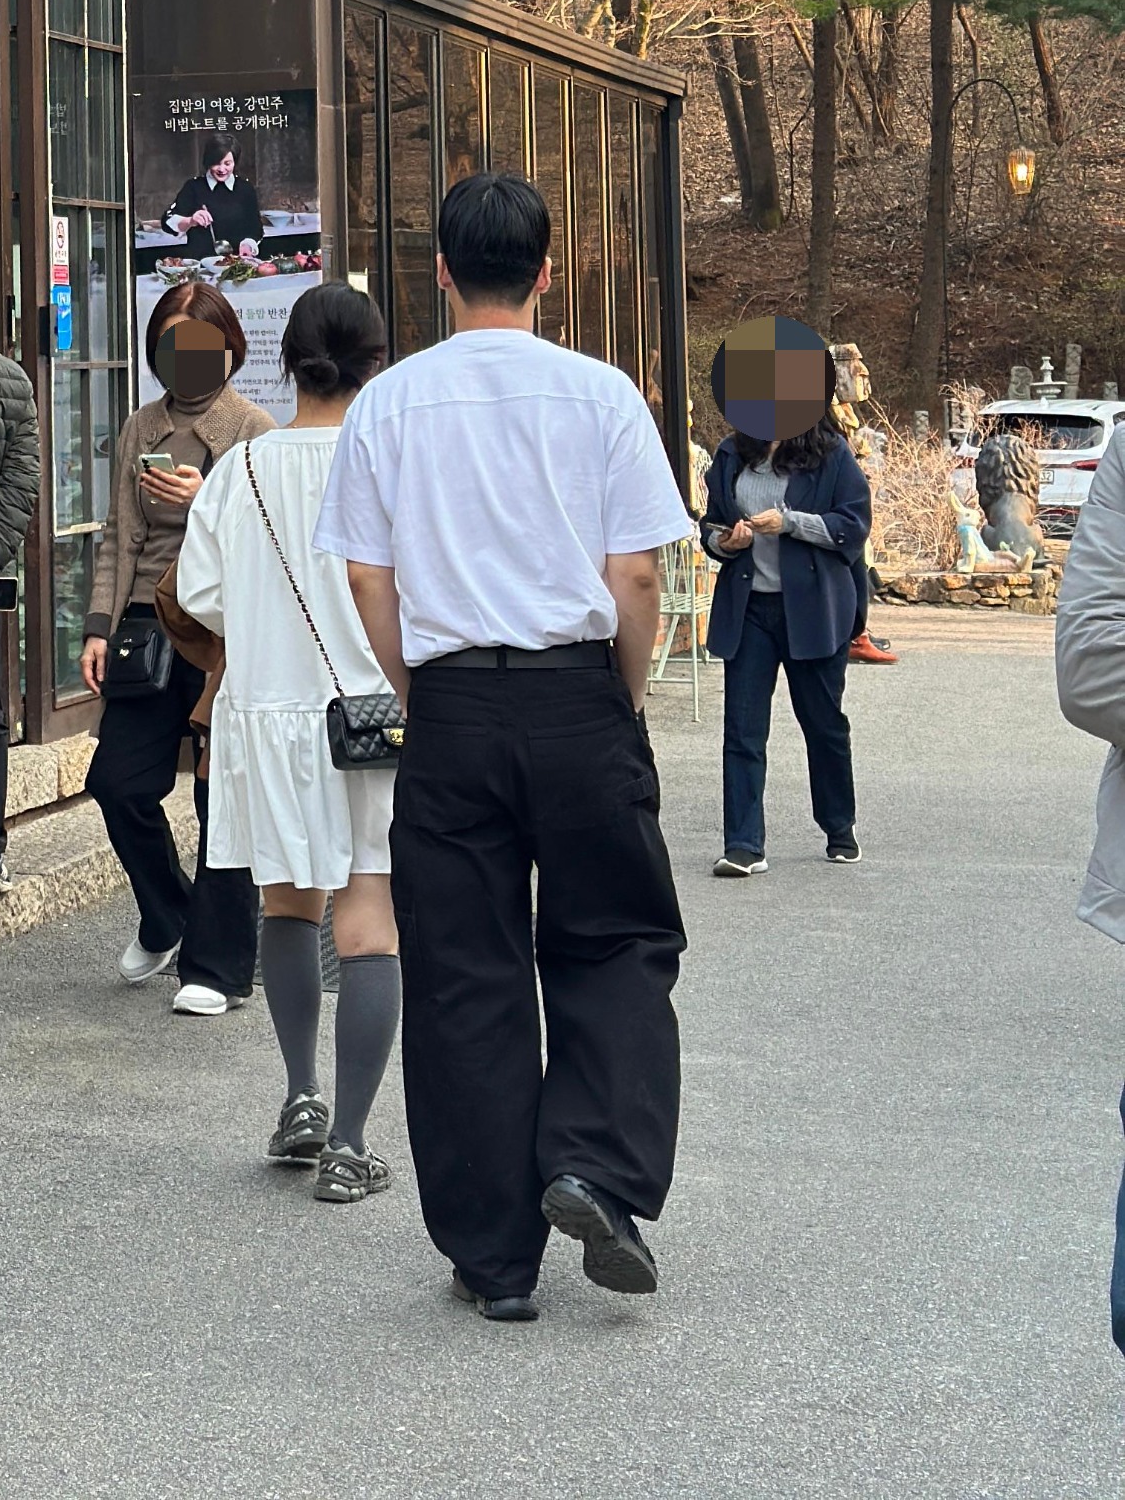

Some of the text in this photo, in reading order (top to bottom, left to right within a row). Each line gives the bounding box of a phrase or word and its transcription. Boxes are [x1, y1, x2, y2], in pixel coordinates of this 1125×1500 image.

[169, 96, 284, 114] 집밥의 여왕, 강민주
[164, 114, 289, 132] 비법노트를 공개하다!
